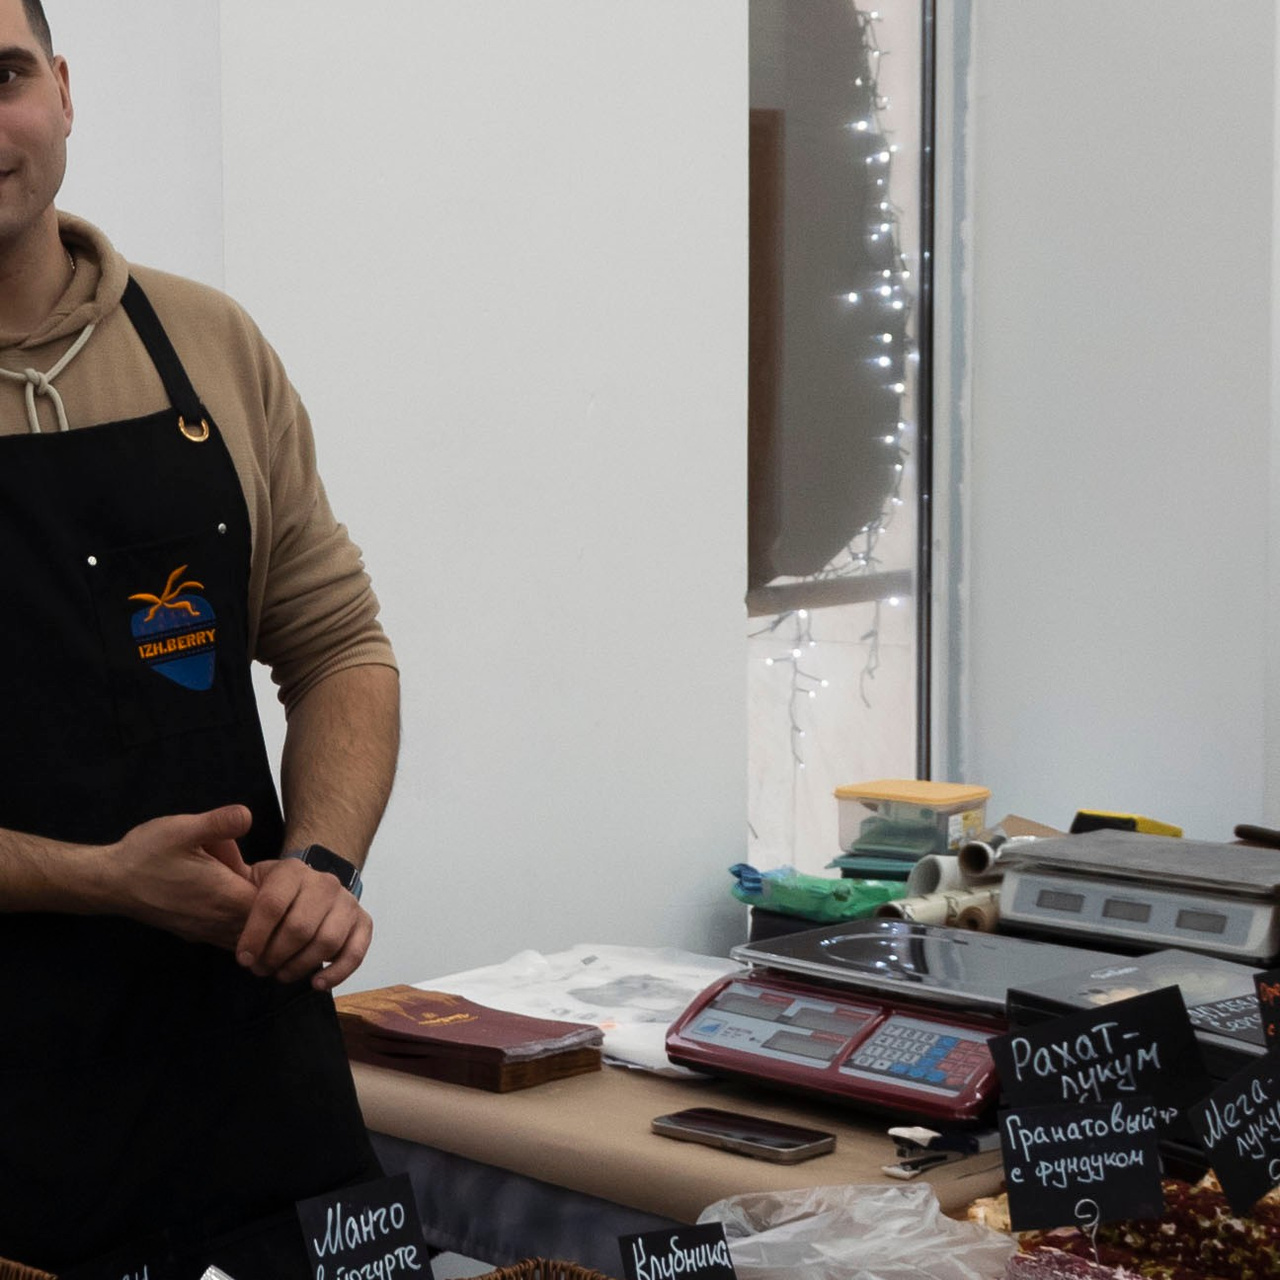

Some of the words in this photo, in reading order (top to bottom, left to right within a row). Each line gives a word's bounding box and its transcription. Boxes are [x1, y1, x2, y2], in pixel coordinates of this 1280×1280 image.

[138, 628, 216, 659] IZH.BERRY
[1062, 1042, 1161, 1104] лукум
[1005, 1101, 1156, 1163] Гранатовый
[1236, 1099, 1280, 1159] луку
[1035, 1149, 1144, 1189] фундуком
[314, 1202, 405, 1258] Манго
